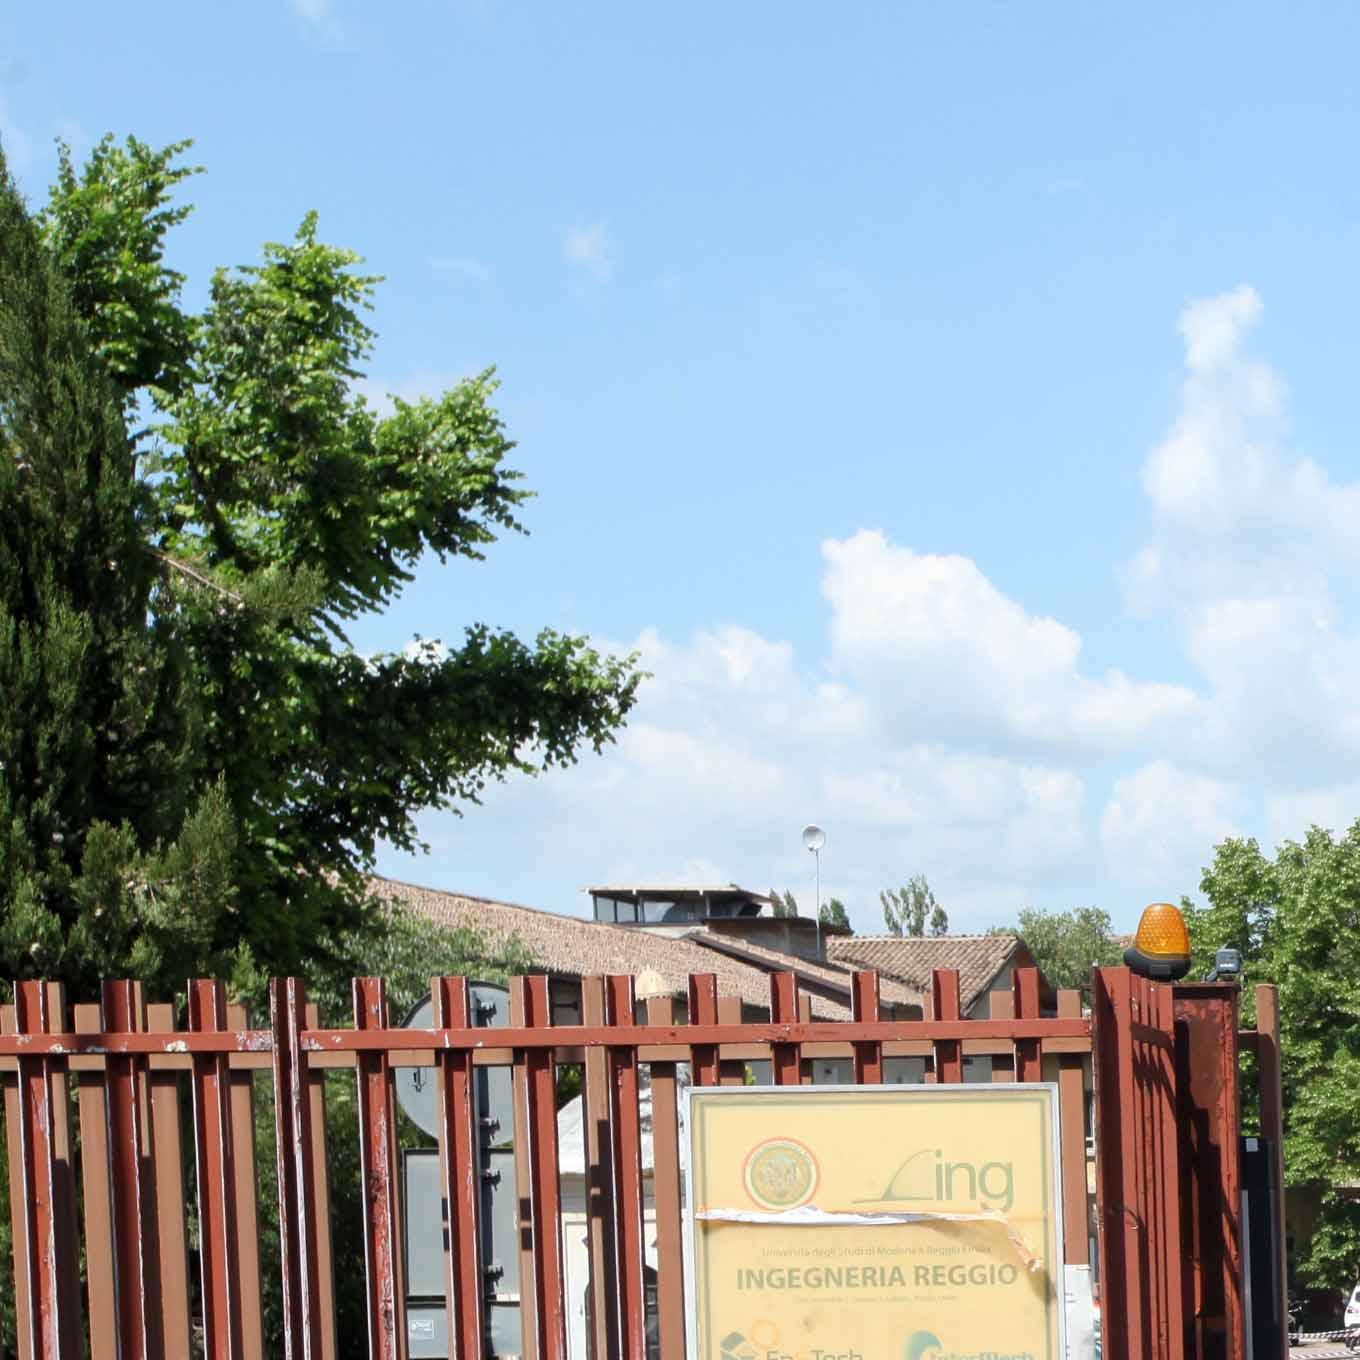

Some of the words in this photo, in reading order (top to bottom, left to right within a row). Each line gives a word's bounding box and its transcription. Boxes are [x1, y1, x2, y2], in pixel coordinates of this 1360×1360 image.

[935, 1149, 1015, 1212] ing
[737, 1266, 906, 1290] INGEGNERIA
[914, 1263, 1018, 1287] REGGIO
